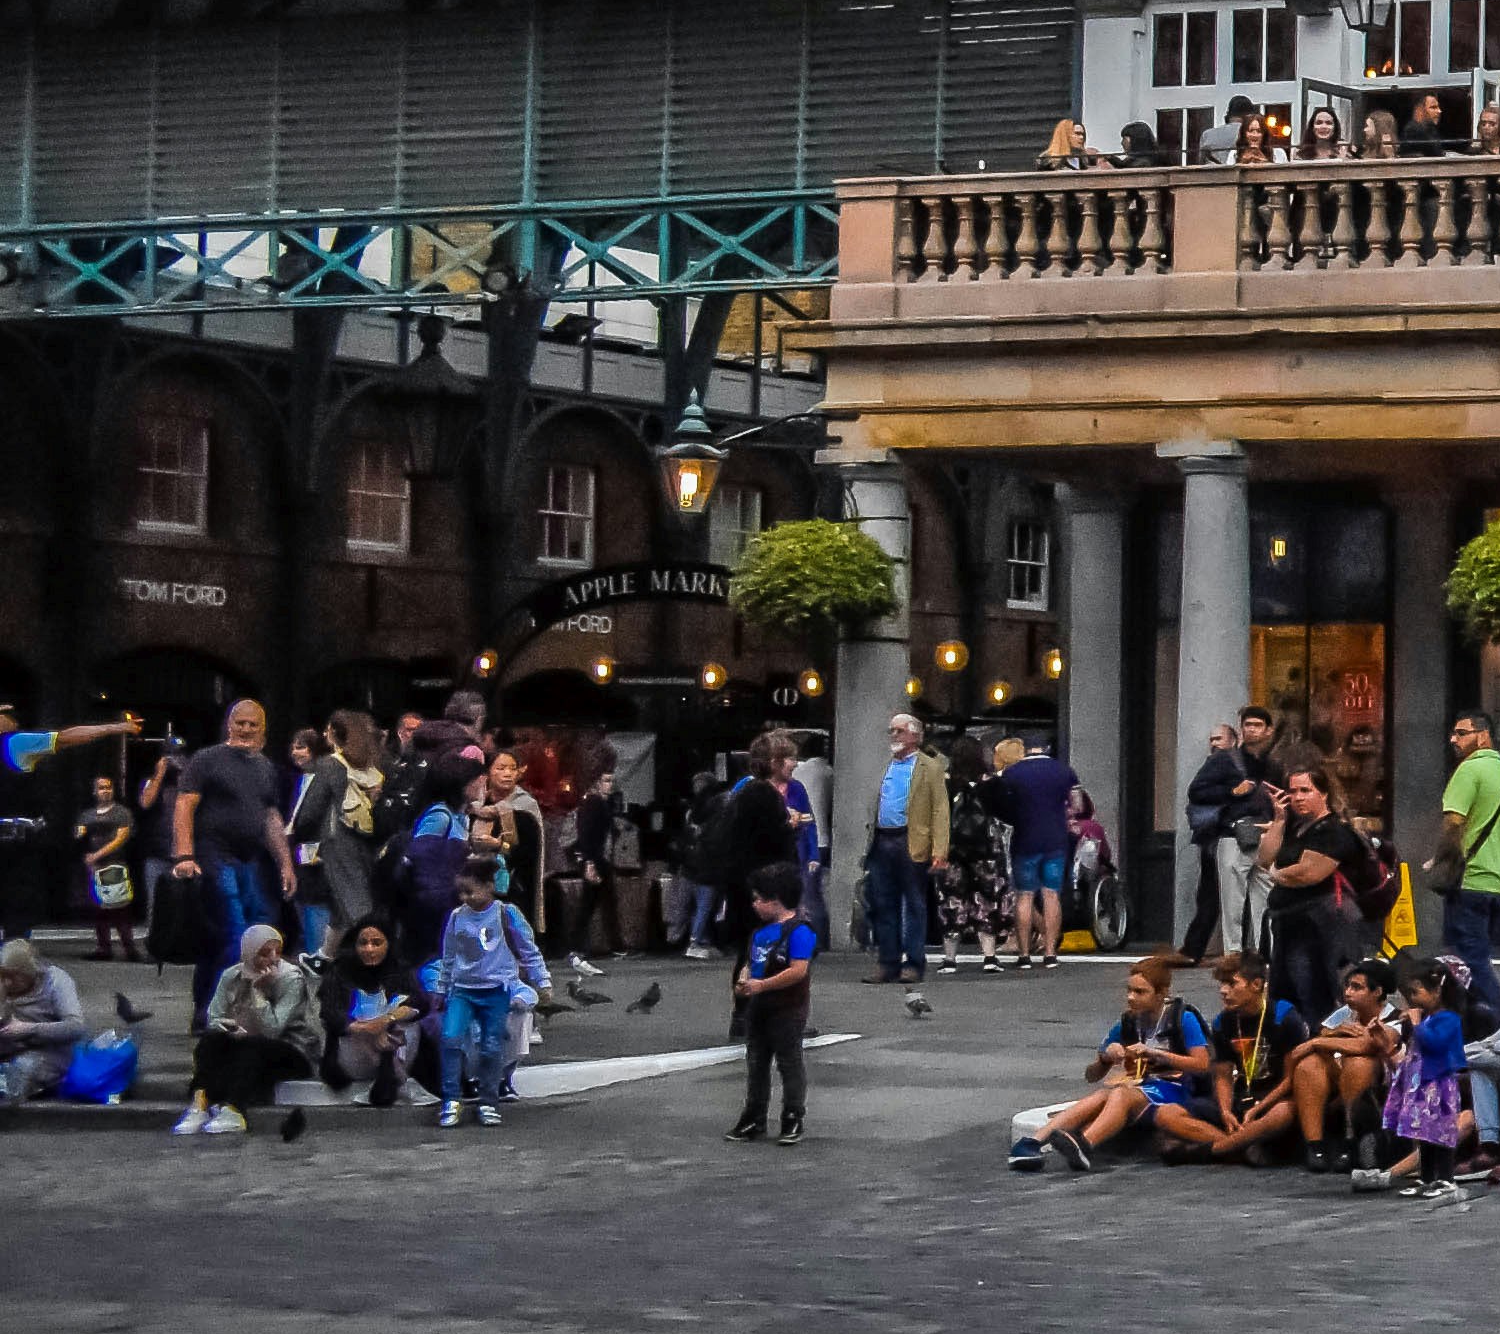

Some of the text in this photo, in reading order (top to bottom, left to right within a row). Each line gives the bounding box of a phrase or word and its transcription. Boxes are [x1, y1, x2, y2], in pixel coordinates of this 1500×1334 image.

[121, 577, 227, 607] TOM FORD
[564, 570, 729, 608] APPLE MARK
